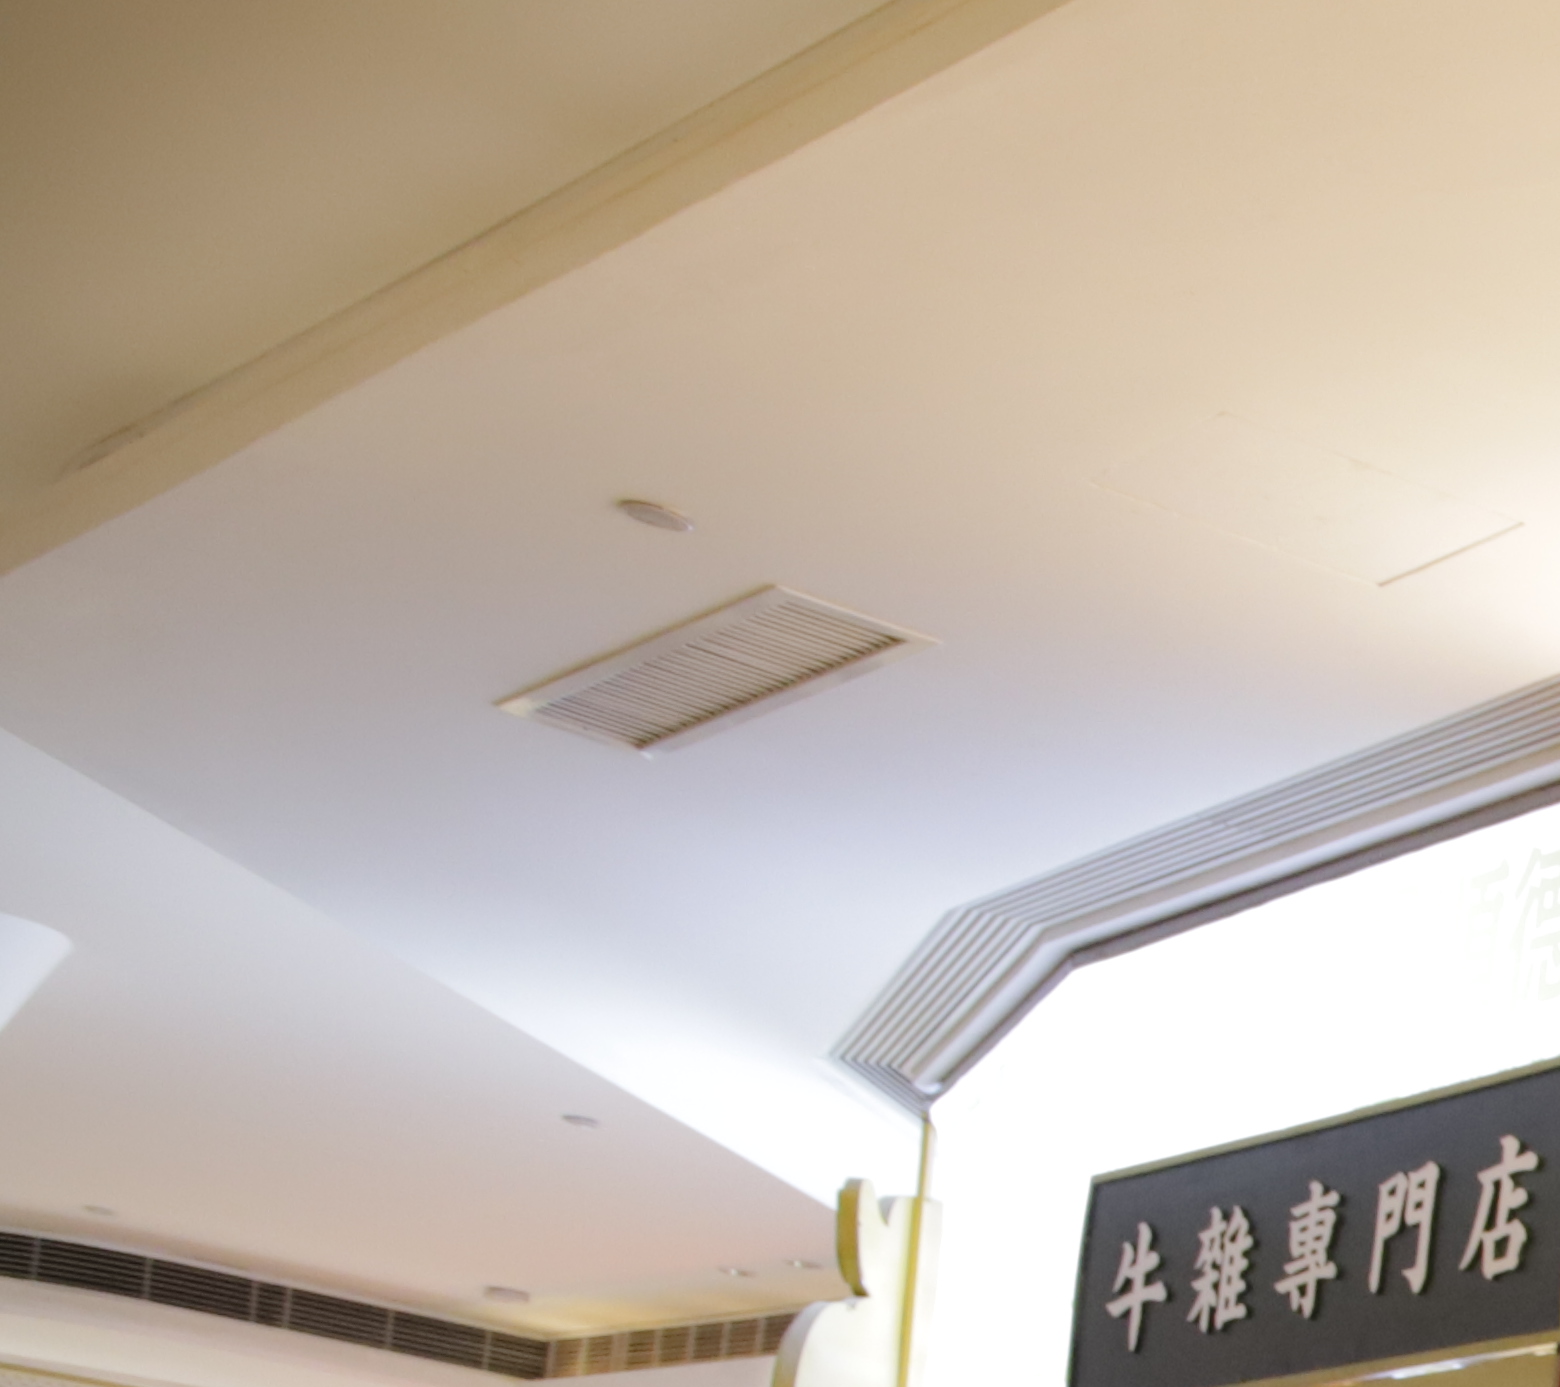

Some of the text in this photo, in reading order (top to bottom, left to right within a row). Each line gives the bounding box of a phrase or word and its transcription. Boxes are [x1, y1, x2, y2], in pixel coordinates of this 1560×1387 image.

[1105, 1135, 1540, 1352] 牛雜專門店
